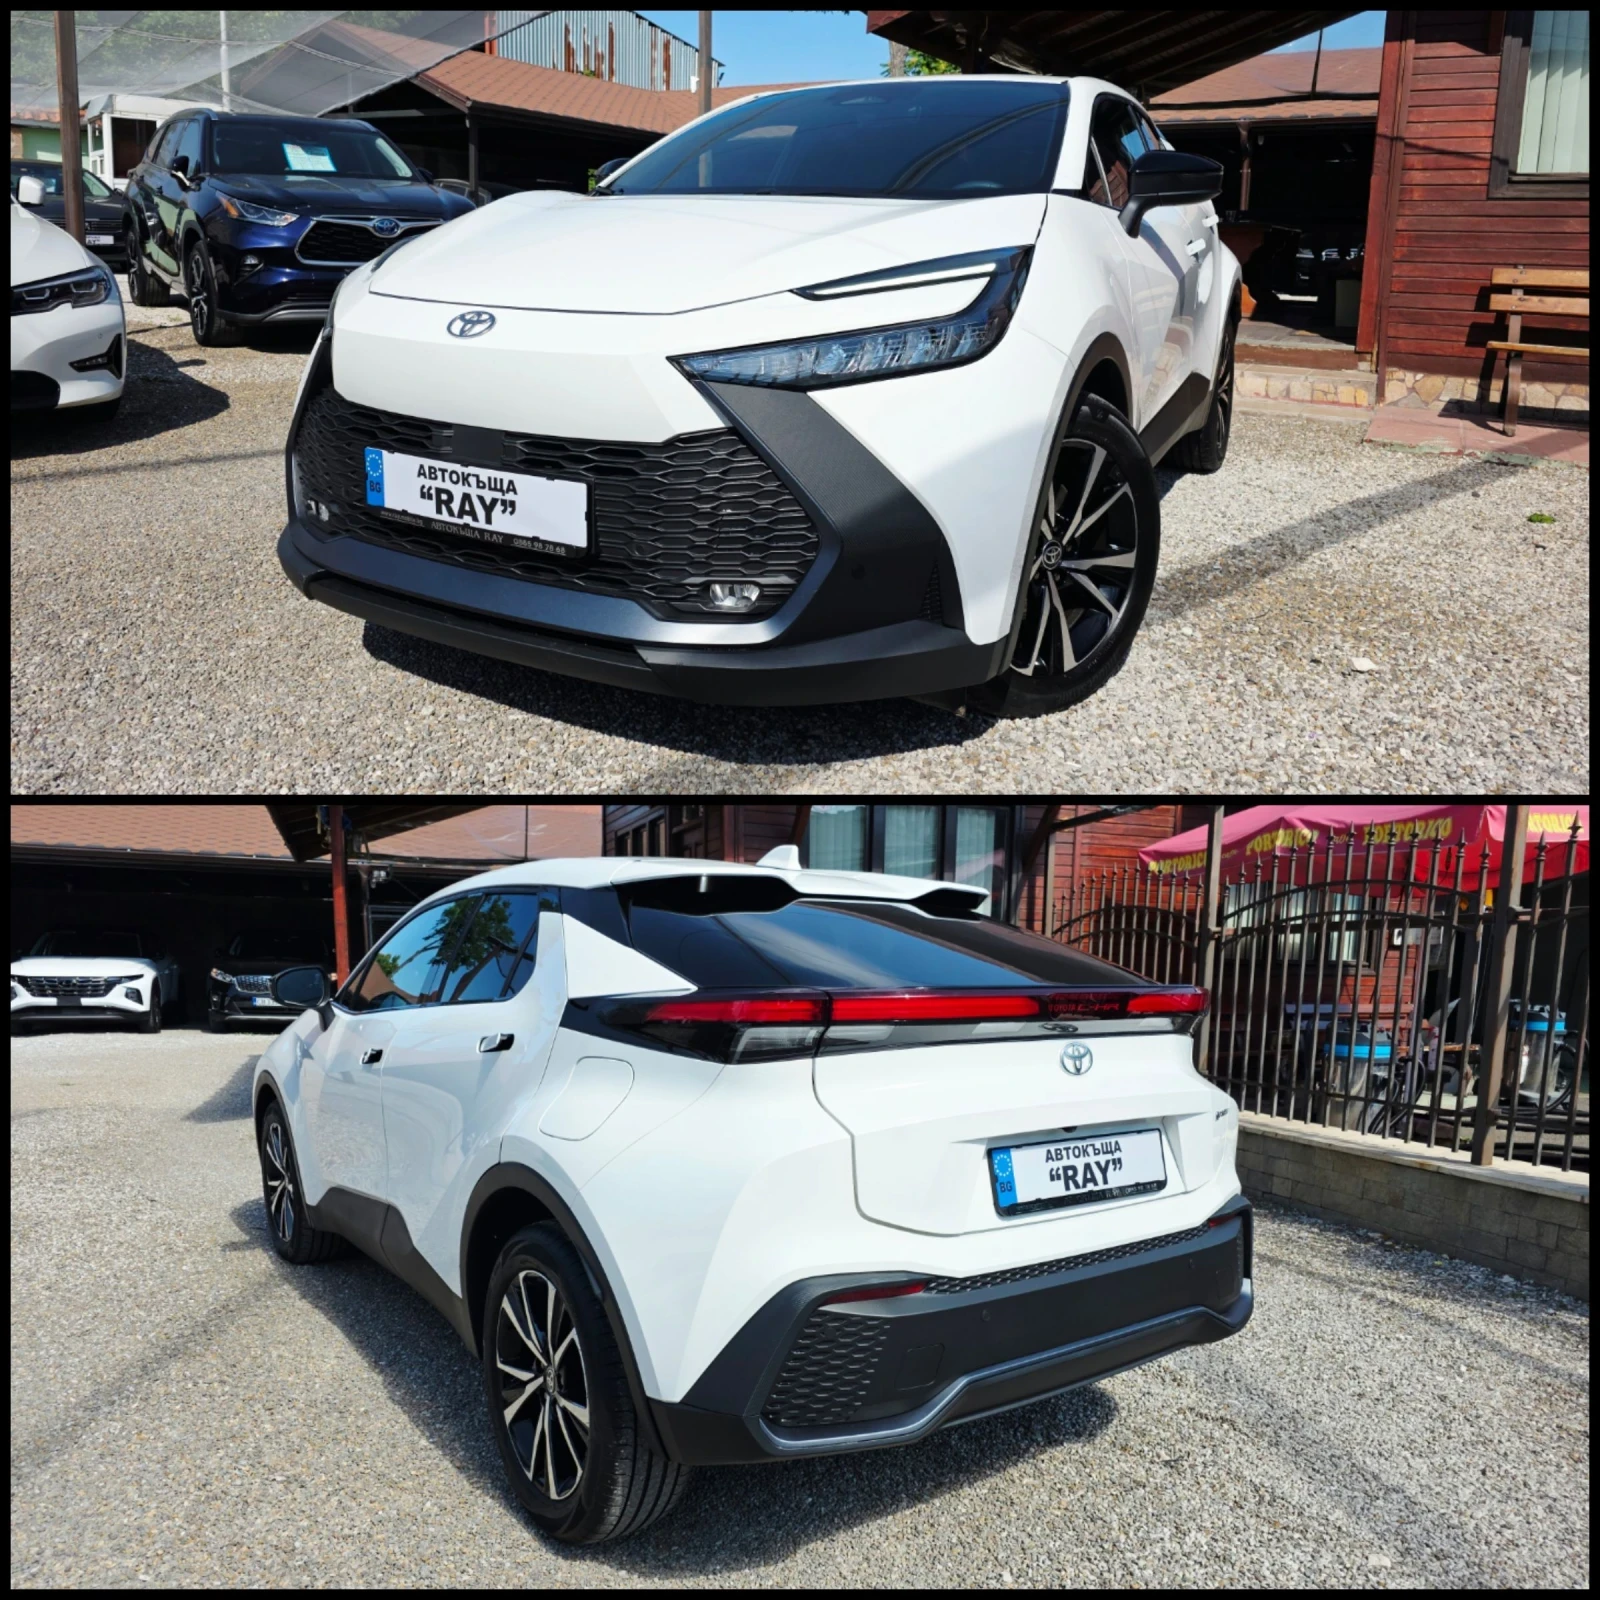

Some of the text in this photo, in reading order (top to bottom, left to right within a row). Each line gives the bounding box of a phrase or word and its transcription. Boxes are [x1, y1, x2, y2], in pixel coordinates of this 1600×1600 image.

[369, 480, 382, 493] BG
[417, 464, 518, 496] АВТОКЪЩА
[420, 484, 516, 525] “RAY”
[431, 521, 504, 544] АВТОКЪЩА RAY
[1048, 1003, 1076, 1012] TOYOTA
[1045, 1140, 1122, 1163] АВТОКЪЩА
[1049, 1157, 1123, 1191] “RAY”
[1000, 1181, 1012, 1193] BG
